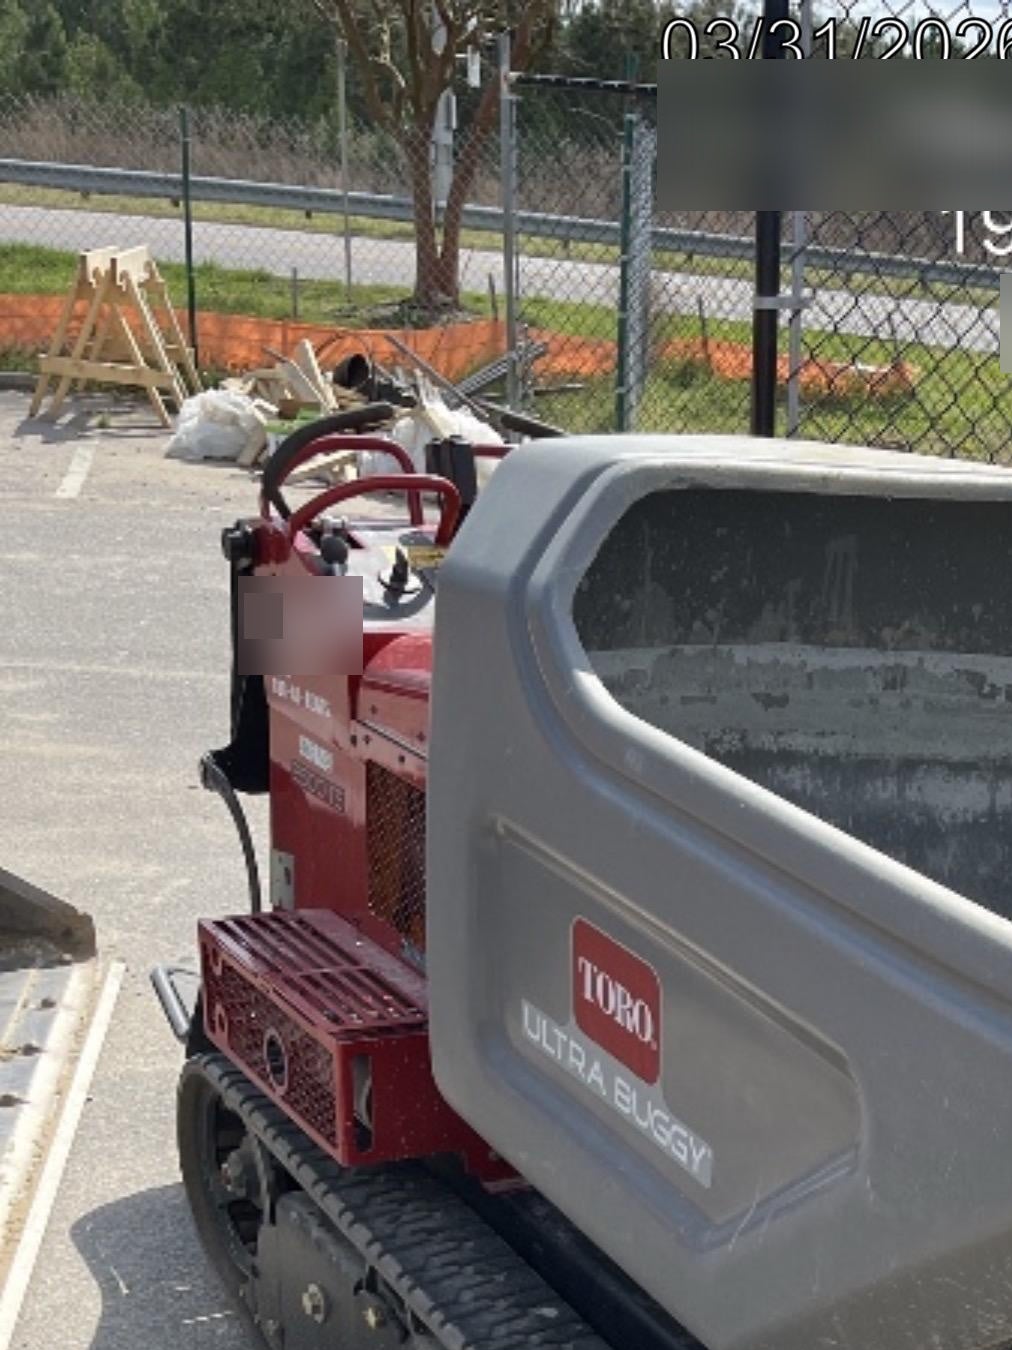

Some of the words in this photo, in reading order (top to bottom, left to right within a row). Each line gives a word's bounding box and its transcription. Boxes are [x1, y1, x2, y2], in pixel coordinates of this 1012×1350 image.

[578, 957, 654, 1043] TORO
[521, 999, 607, 1096] ULTRA
[613, 1077, 713, 1174] BUGGY
